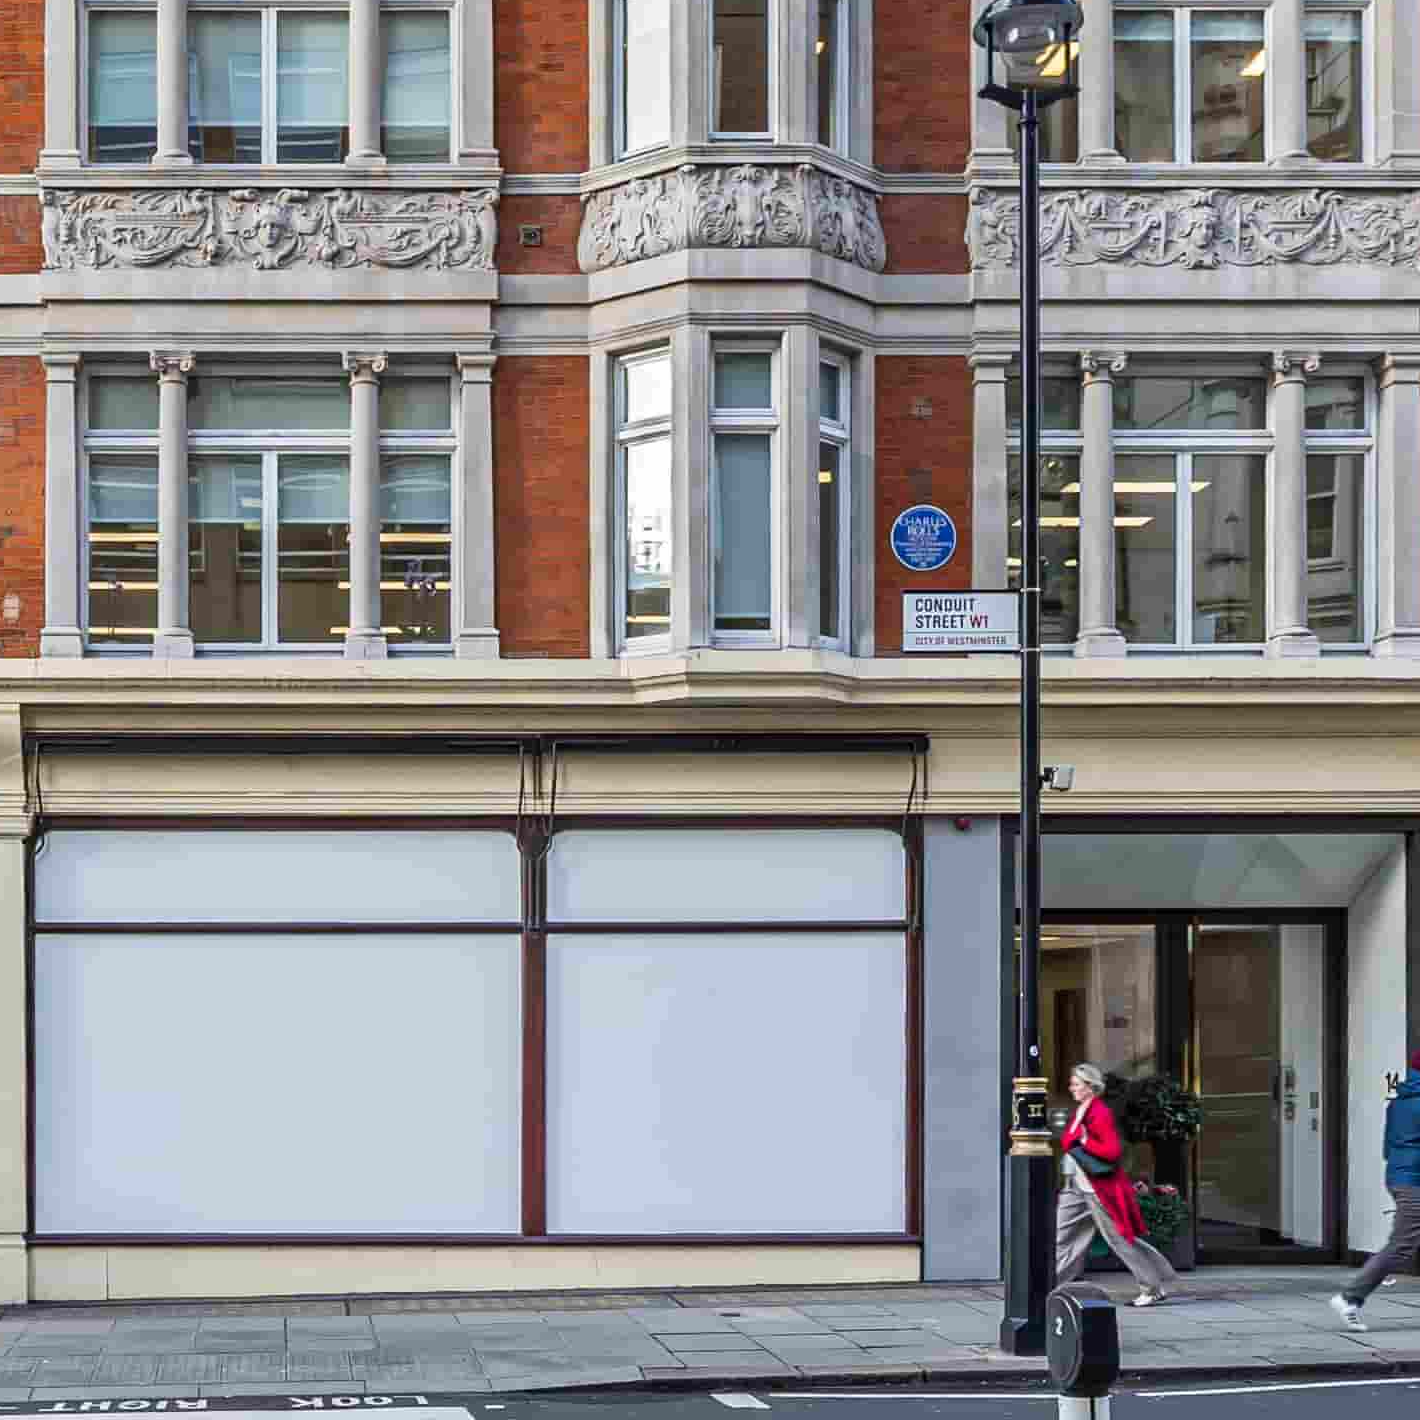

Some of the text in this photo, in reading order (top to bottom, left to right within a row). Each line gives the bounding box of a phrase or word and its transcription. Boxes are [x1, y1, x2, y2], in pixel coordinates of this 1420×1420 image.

[915, 597, 976, 613] CONDUIT
[915, 614, 989, 629] STREET W1
[947, 635, 1007, 645] WESTMINSTER
[37, 1395, 428, 1412] LOOK RIGHT
